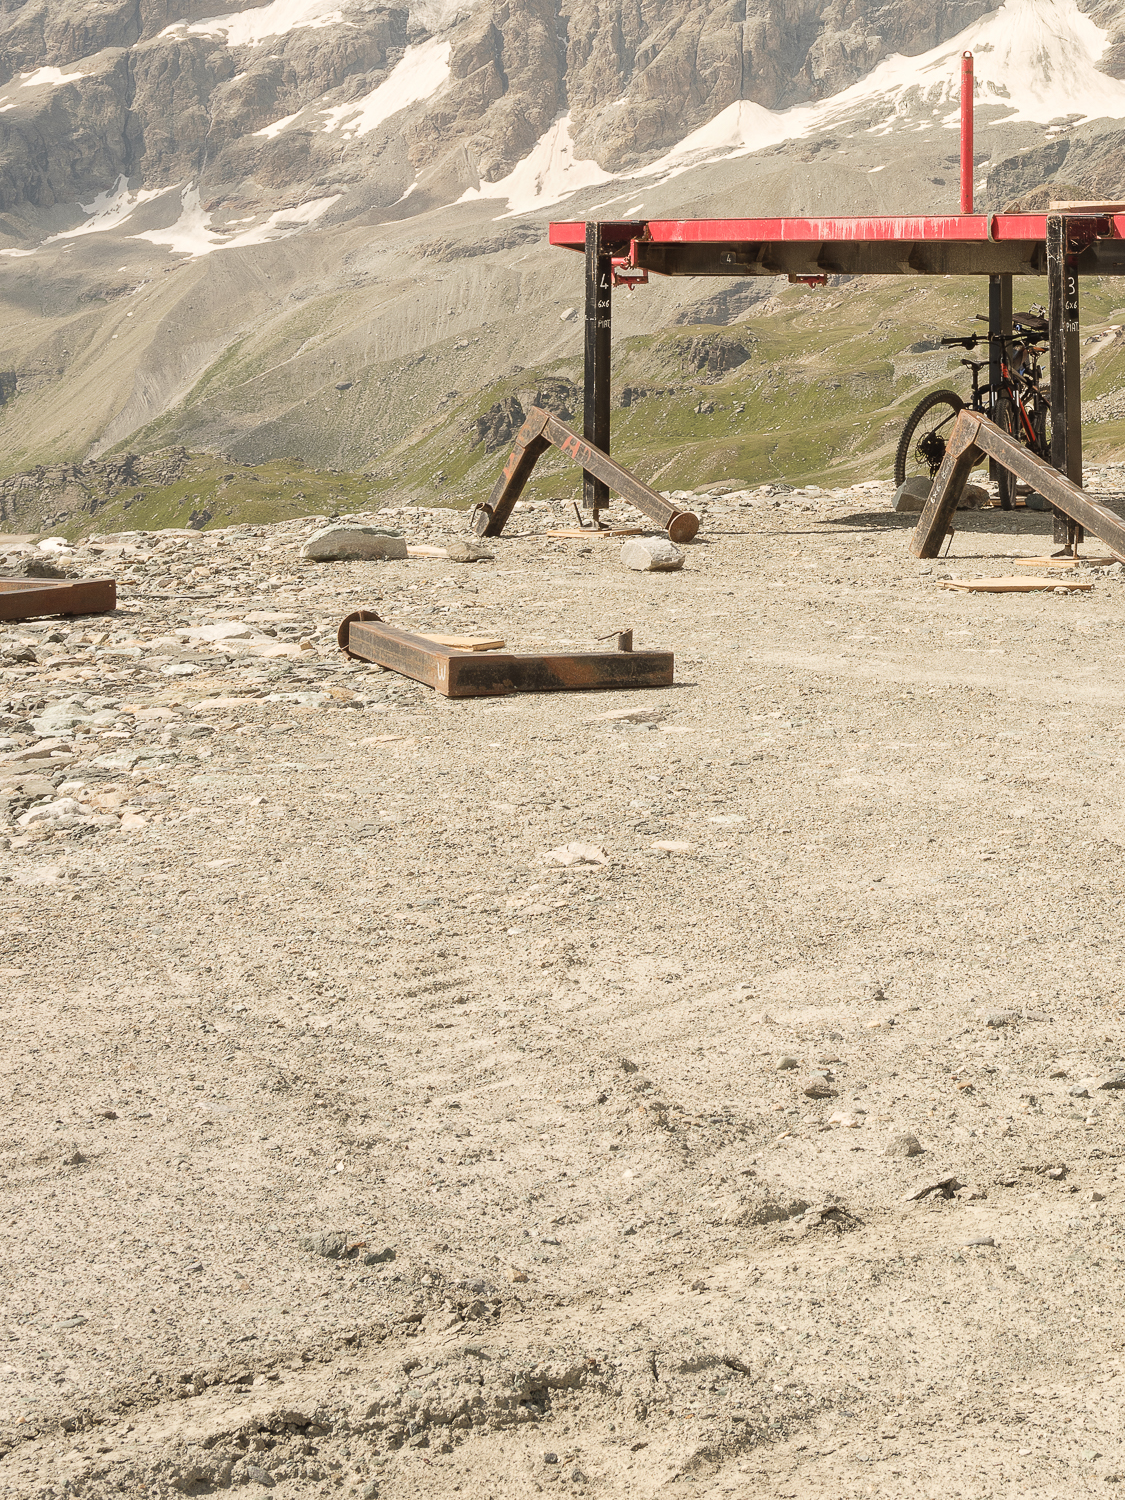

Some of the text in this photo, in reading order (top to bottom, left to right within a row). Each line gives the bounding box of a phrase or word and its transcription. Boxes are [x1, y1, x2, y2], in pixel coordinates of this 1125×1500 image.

[726, 253, 732, 263] 4
[599, 273, 609, 290] 4
[1067, 276, 1076, 295] 3
